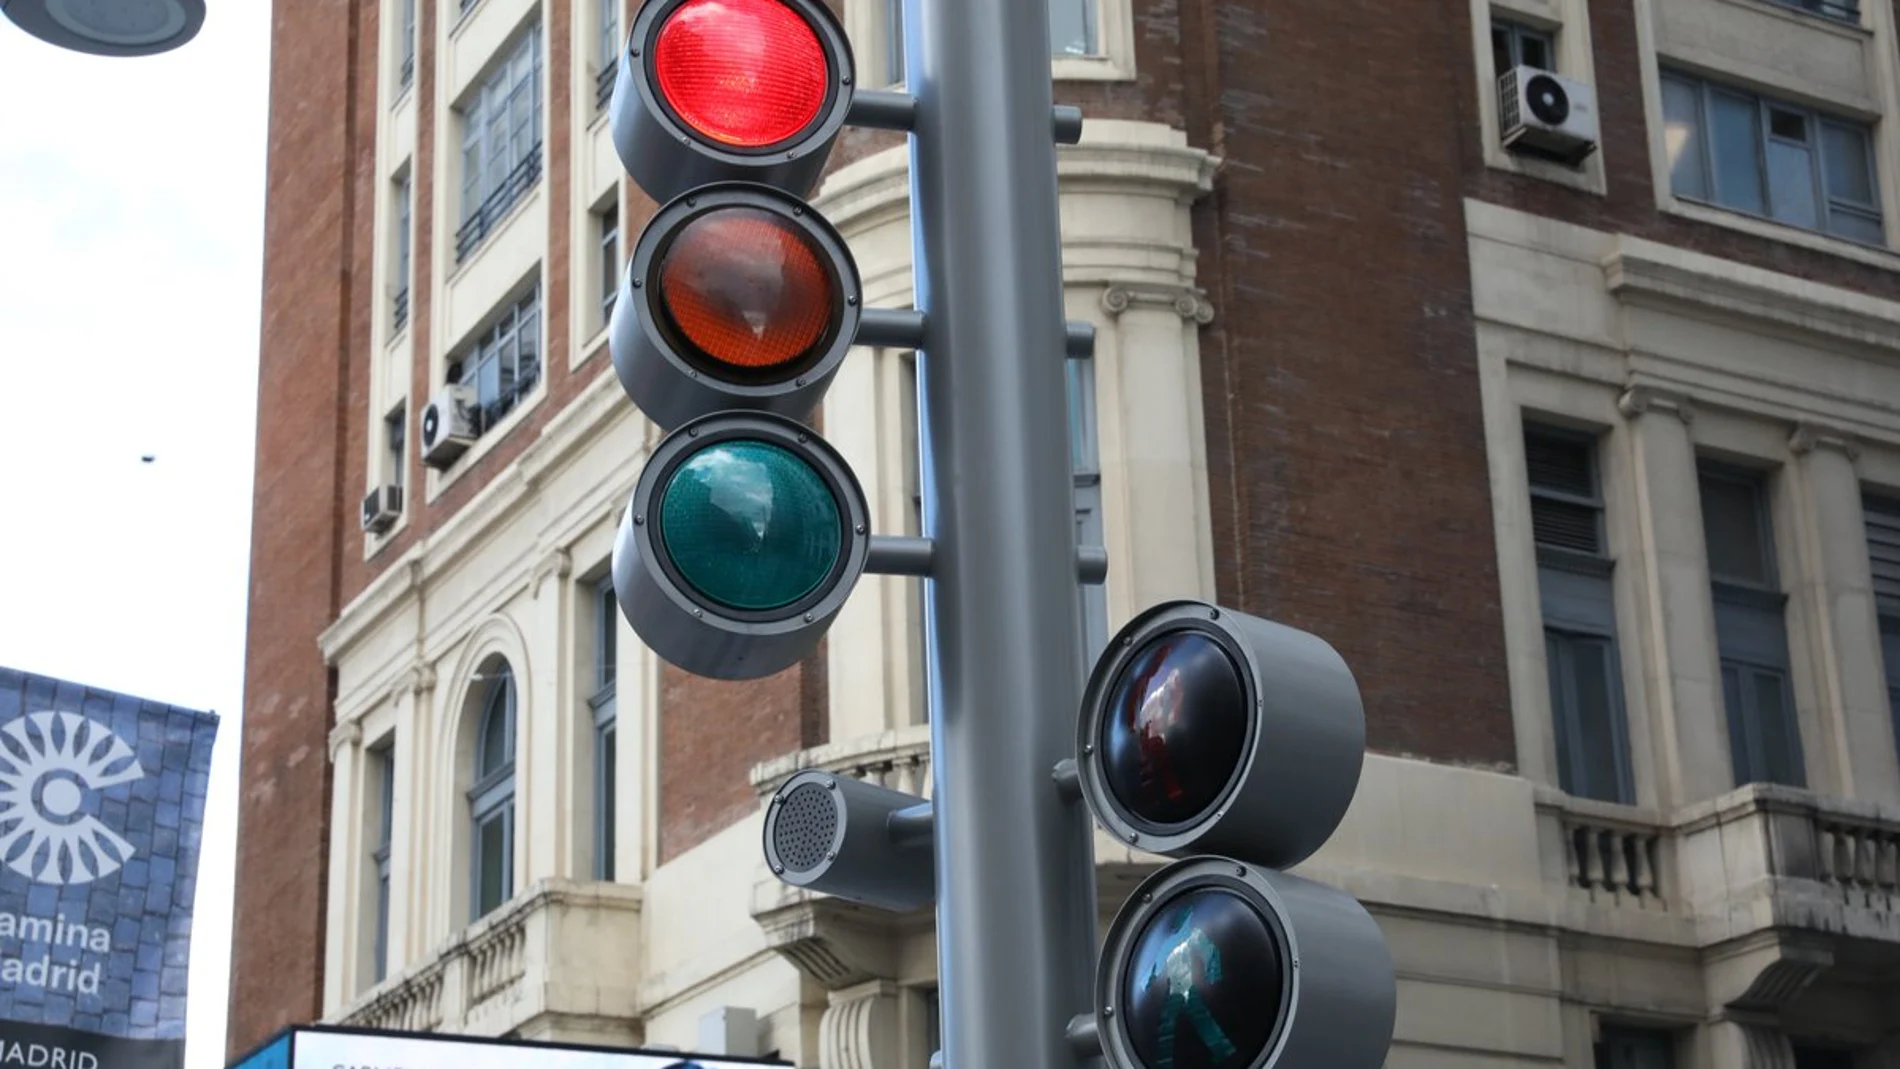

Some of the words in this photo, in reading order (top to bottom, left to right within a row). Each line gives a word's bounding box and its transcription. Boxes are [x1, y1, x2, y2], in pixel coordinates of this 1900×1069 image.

[0, 912, 111, 953] amina
[0, 954, 101, 995] adrid
[0, 1039, 98, 1069] ADRID
